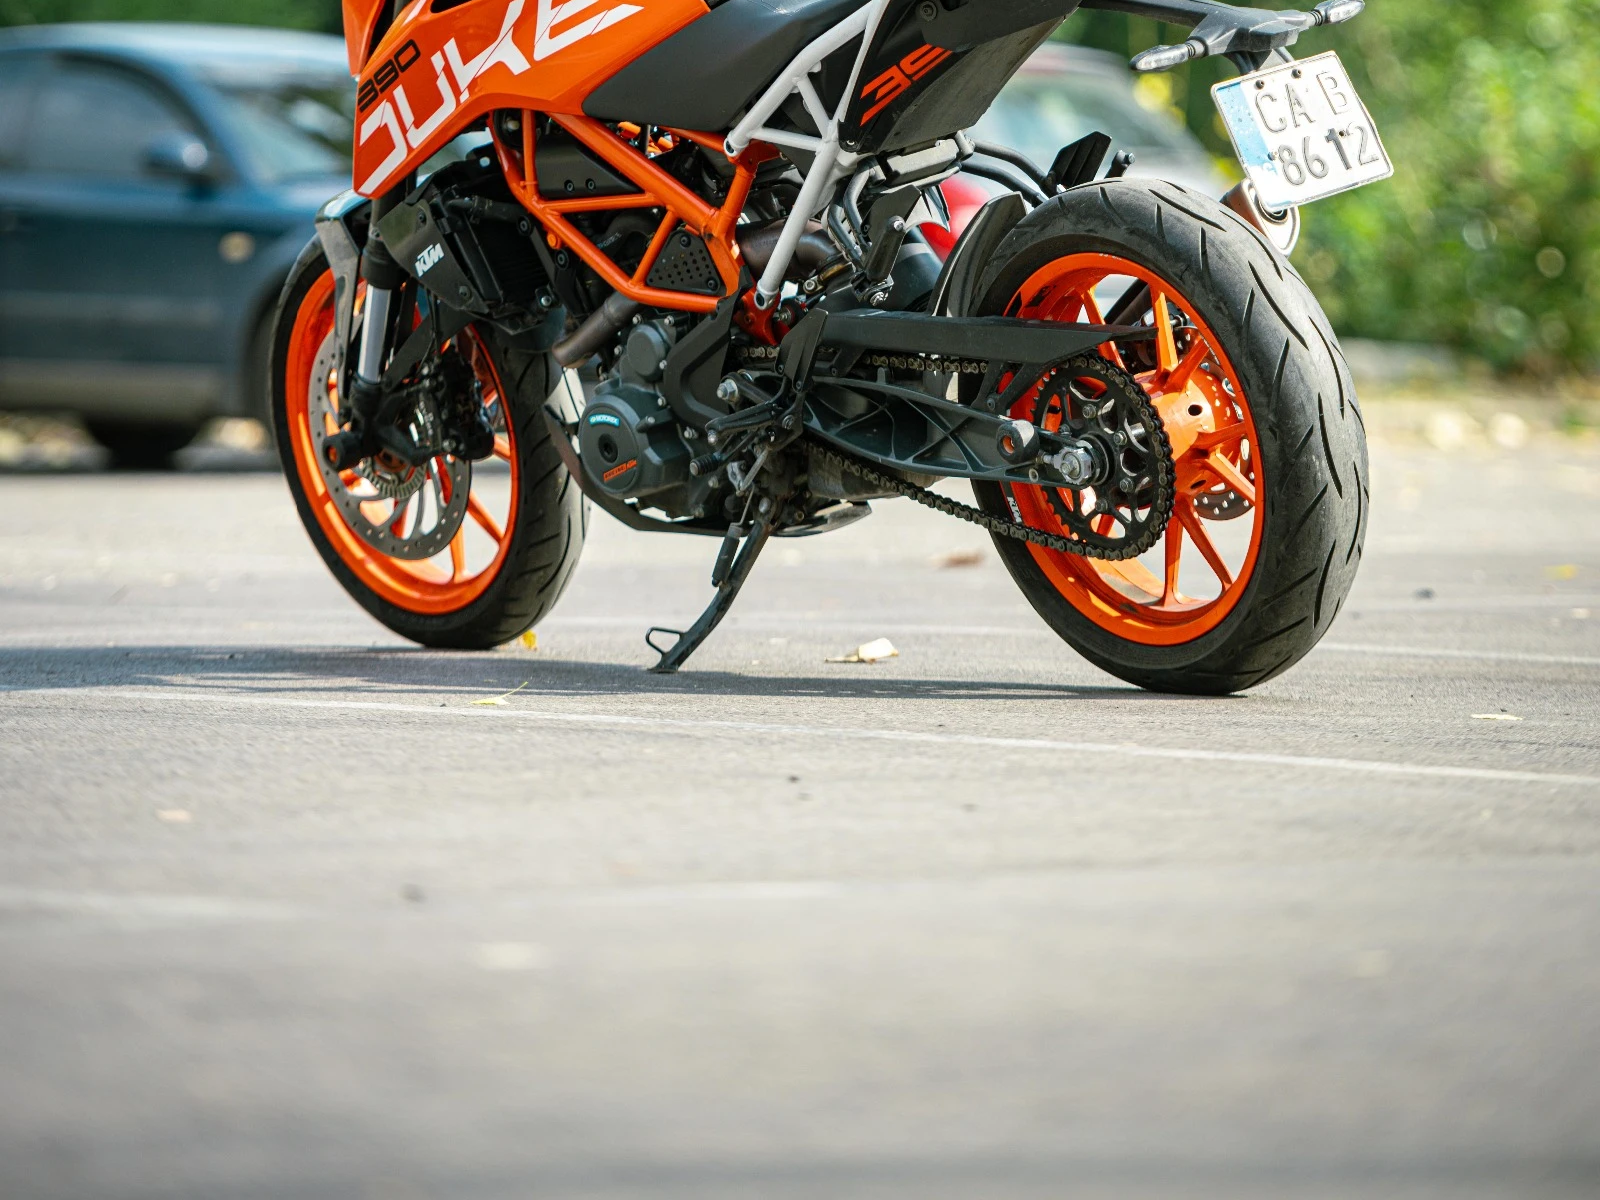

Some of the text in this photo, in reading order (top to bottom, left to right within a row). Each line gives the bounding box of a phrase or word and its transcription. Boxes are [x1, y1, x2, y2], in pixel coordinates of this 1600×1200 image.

[358, 39, 421, 113] 390
[1255, 83, 1316, 134] CA
[1277, 122, 1380, 186] 8612
[414, 242, 445, 278] KTM
